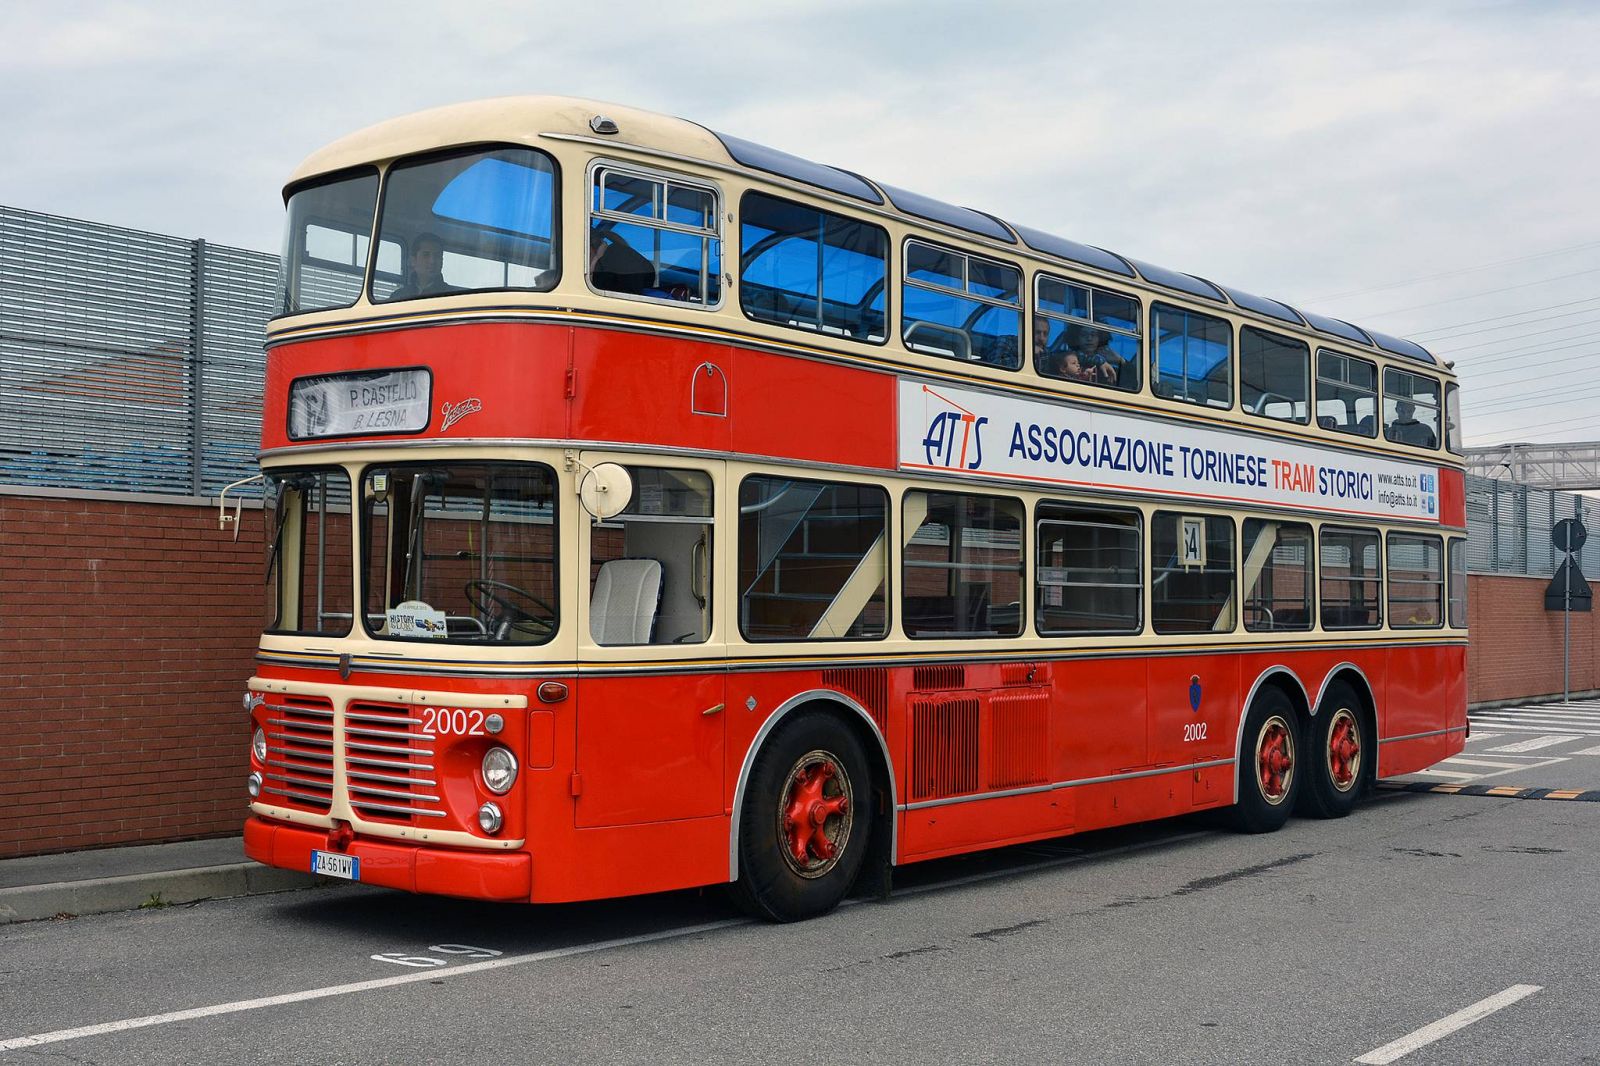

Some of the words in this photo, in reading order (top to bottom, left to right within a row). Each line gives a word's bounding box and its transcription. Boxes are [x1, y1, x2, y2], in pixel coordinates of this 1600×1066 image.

[362, 381, 417, 406] CASTELLO
[367, 409, 407, 428] LESNA
[922, 411, 989, 470] ATTS
[1008, 421, 1174, 477] ASSOCIAZIONE
[1179, 445, 1267, 487] TORINESE
[1271, 459, 1315, 493] TRAM
[1318, 466, 1373, 500] STORICI
[1377, 473, 1417, 488] www.atts.to.it
[1378, 490, 1418, 508] info@atts.to.it
[422, 707, 485, 736] 2002
[1183, 722, 1207, 742] 2002
